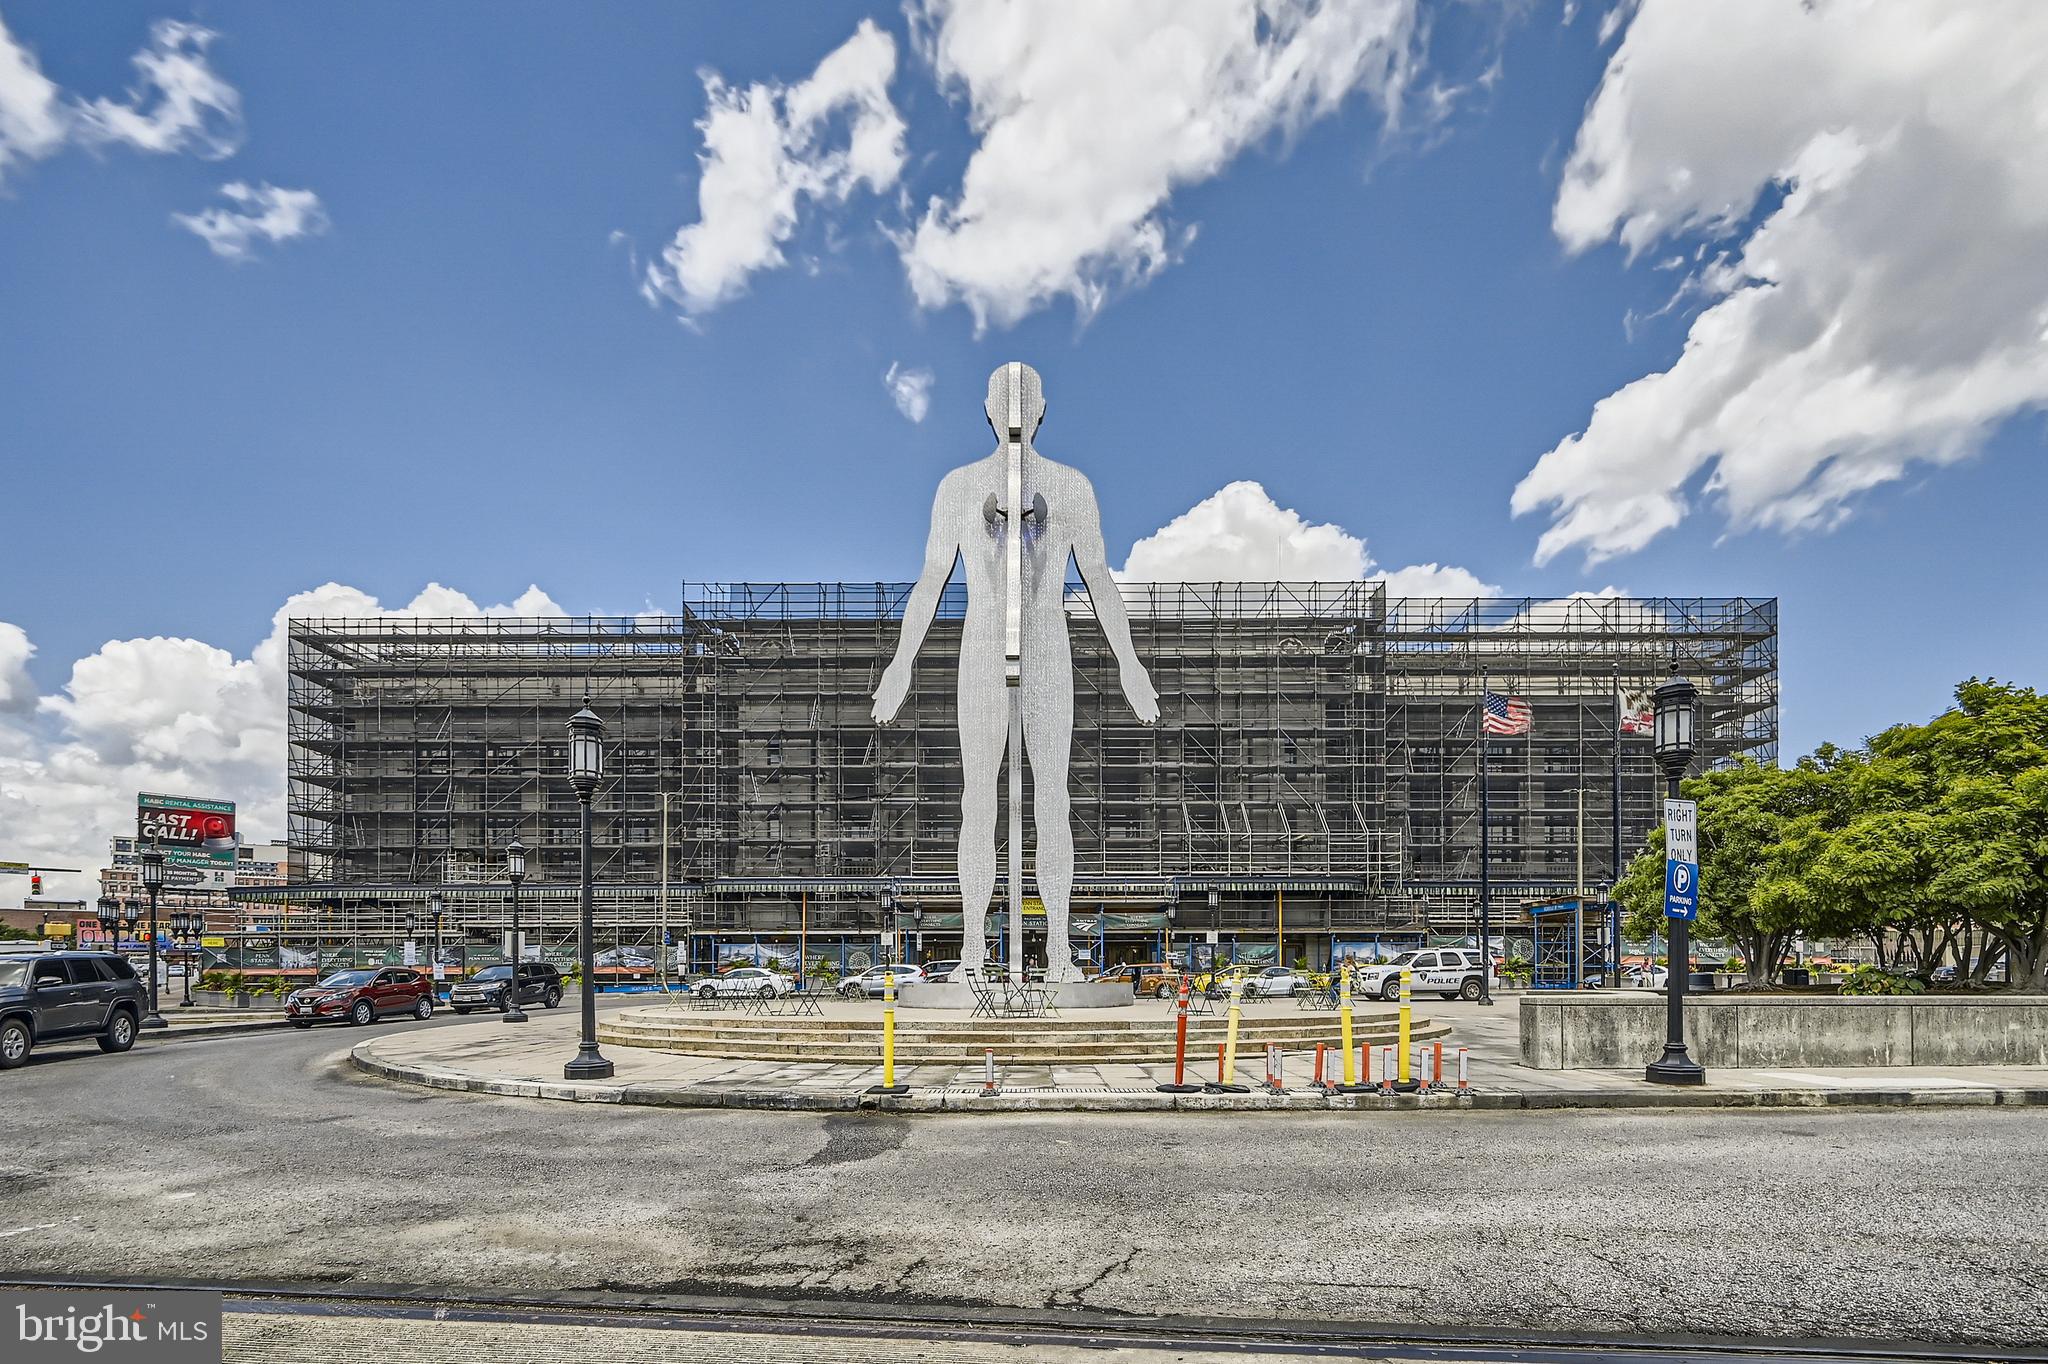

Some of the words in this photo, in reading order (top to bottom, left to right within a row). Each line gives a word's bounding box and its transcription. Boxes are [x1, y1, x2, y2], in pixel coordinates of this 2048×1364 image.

[165, 800, 191, 808] RENTAL
[192, 803, 232, 811] ASSISTANCE
[141, 812, 192, 828] LAST
[1668, 808, 1692, 822] RIGHT
[143, 825, 198, 841] CALL!
[1670, 828, 1692, 842] TURN
[1671, 848, 1692, 862] ONLY
[1677, 868, 1687, 889] P
[1669, 895, 1692, 906] PARKING
